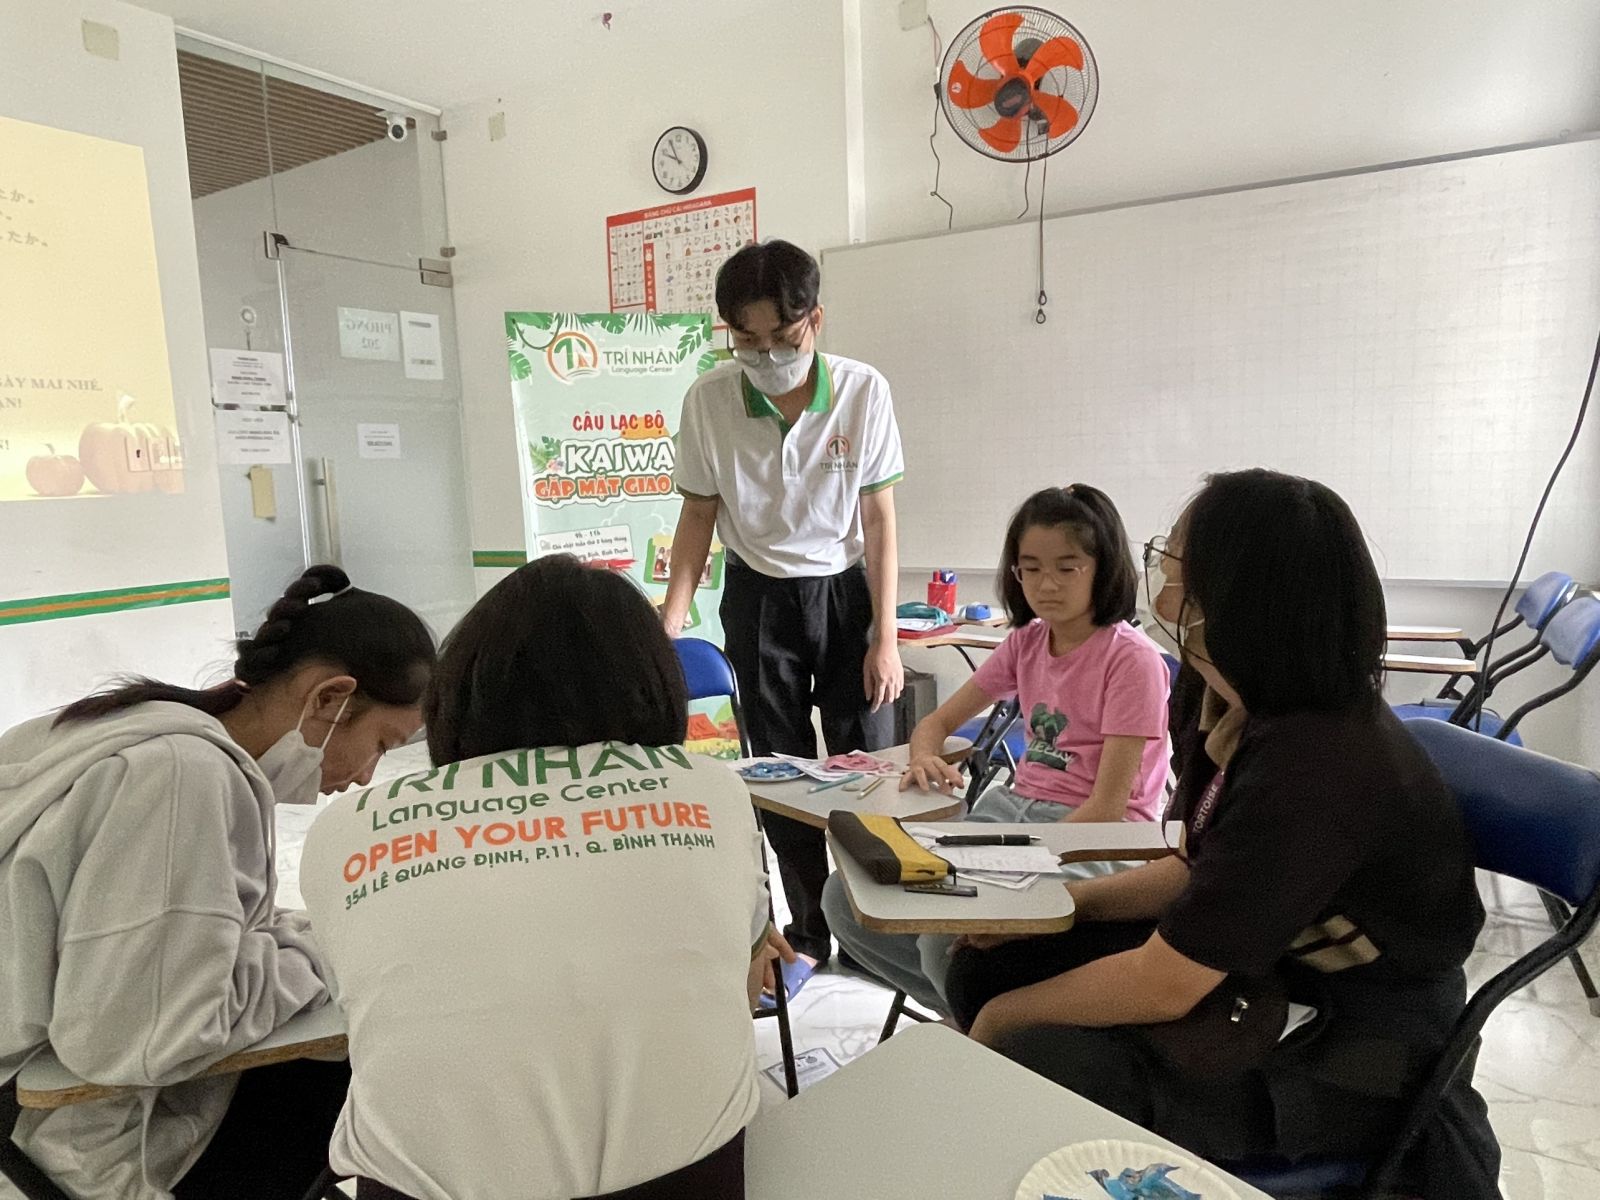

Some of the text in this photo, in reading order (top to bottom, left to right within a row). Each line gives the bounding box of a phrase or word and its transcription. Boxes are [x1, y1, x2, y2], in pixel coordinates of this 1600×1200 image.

[611, 365, 673, 375] Language Center
[632, 347, 680, 365] NHÂN
[572, 409, 665, 436] CÂU LẠC BỘ
[565, 441, 675, 474] KAIWA
[534, 474, 576, 503] GẶP
[577, 473, 621, 501] MẶT
[622, 472, 672, 497] GIAO
[372, 776, 670, 832] Language Center
[343, 802, 712, 883] OPEN YOUR FUTURE
[345, 832, 716, 910] 354 LÊ QUANG ĐỊNH, P.11, Q. BÌNH THẠNH
